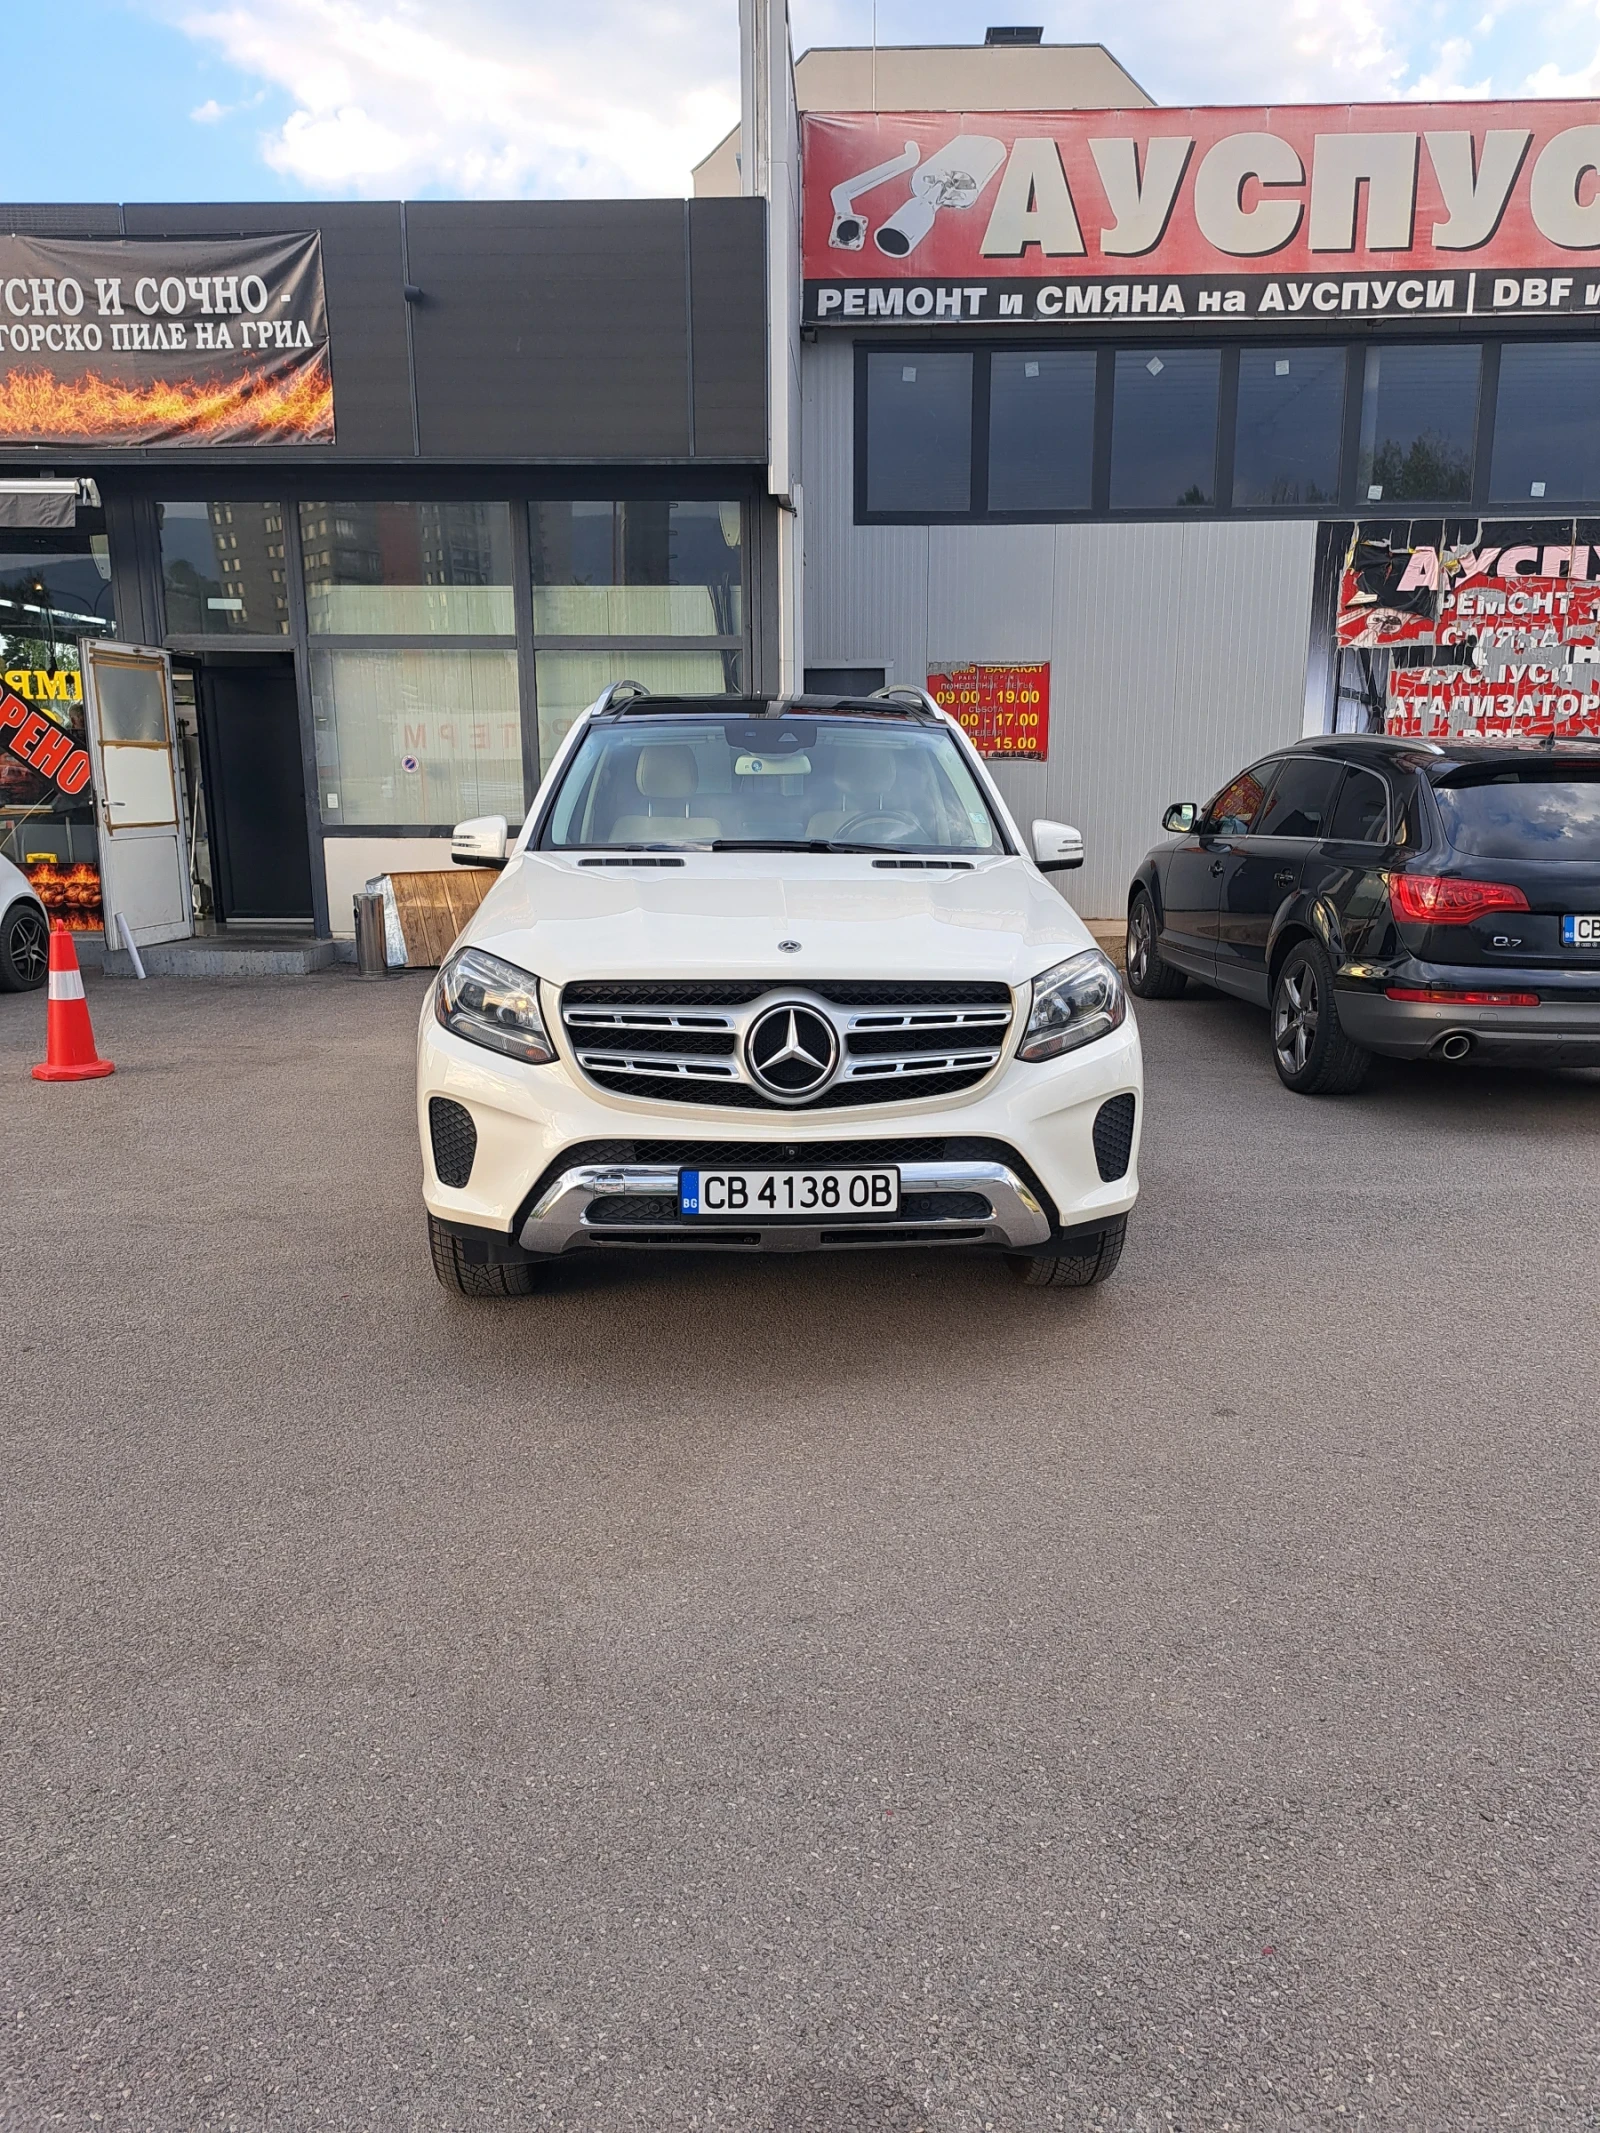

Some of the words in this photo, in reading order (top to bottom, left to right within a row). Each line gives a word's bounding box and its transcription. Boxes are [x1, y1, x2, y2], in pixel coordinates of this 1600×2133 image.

[0, 277, 84, 316] СНО
[94, 278, 124, 315] И
[135, 274, 268, 315] СОЧНО
[817, 285, 988, 316] РЕМОНТ
[999, 292, 1023, 315] и
[1035, 282, 1186, 314] СМЯНА
[1197, 288, 1245, 312] на
[1257, 278, 1456, 312] АУСПУСИ
[1492, 278, 1574, 307] DBF
[110, 322, 187, 351] ПИЛЕ
[194, 321, 234, 350] НА
[241, 320, 314, 349] ГРИЛ
[1396, 545, 1600, 591] АУСП
[1438, 591, 1575, 616] РЕМОНТ
[936, 690, 980, 704] 09.00
[996, 690, 1040, 704] 19.00
[996, 713, 1038, 727] 17.00
[0, 684, 91, 794] РЕНО
[993, 736, 1037, 749] 15.00
[1492, 936, 1522, 948] Q7
[683, 1198, 697, 1209] BG
[704, 1176, 748, 1209] CB
[757, 1175, 840, 1209] 4138
